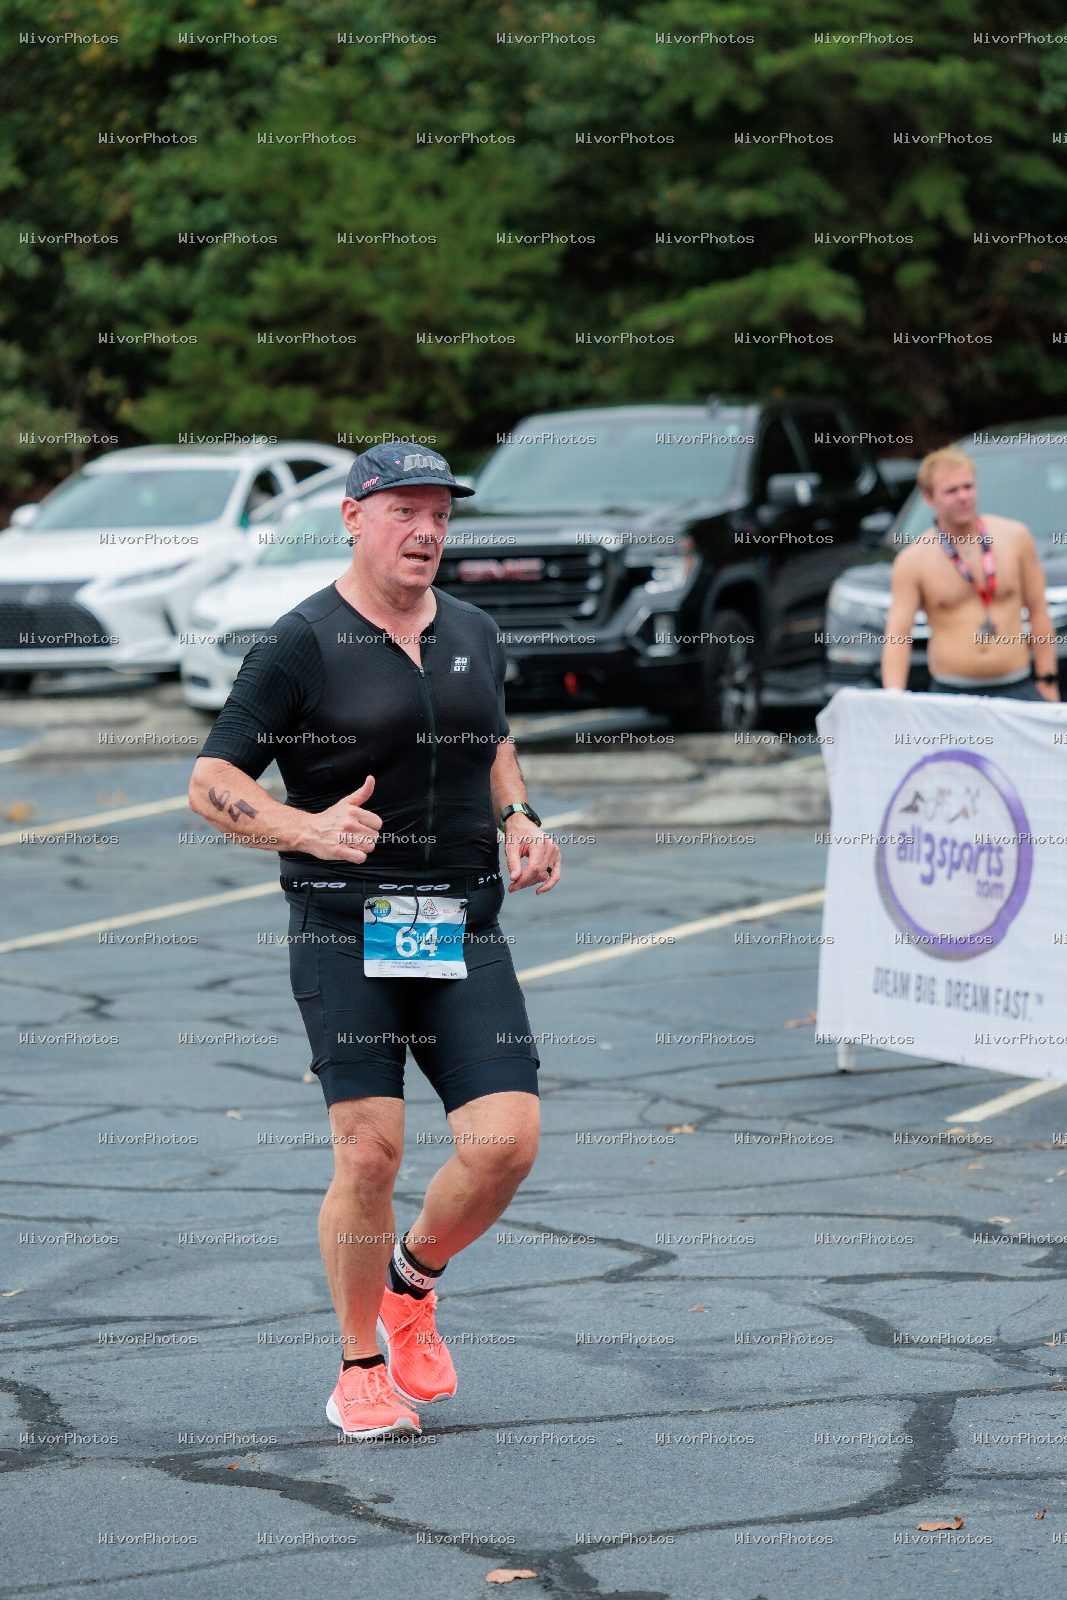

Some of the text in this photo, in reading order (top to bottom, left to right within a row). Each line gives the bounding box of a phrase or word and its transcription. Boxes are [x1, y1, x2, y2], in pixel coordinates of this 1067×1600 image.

[396, 926, 438, 958] 64
[944, 979, 990, 1015] DREAM
[398, 1258, 426, 1286] MYLA
